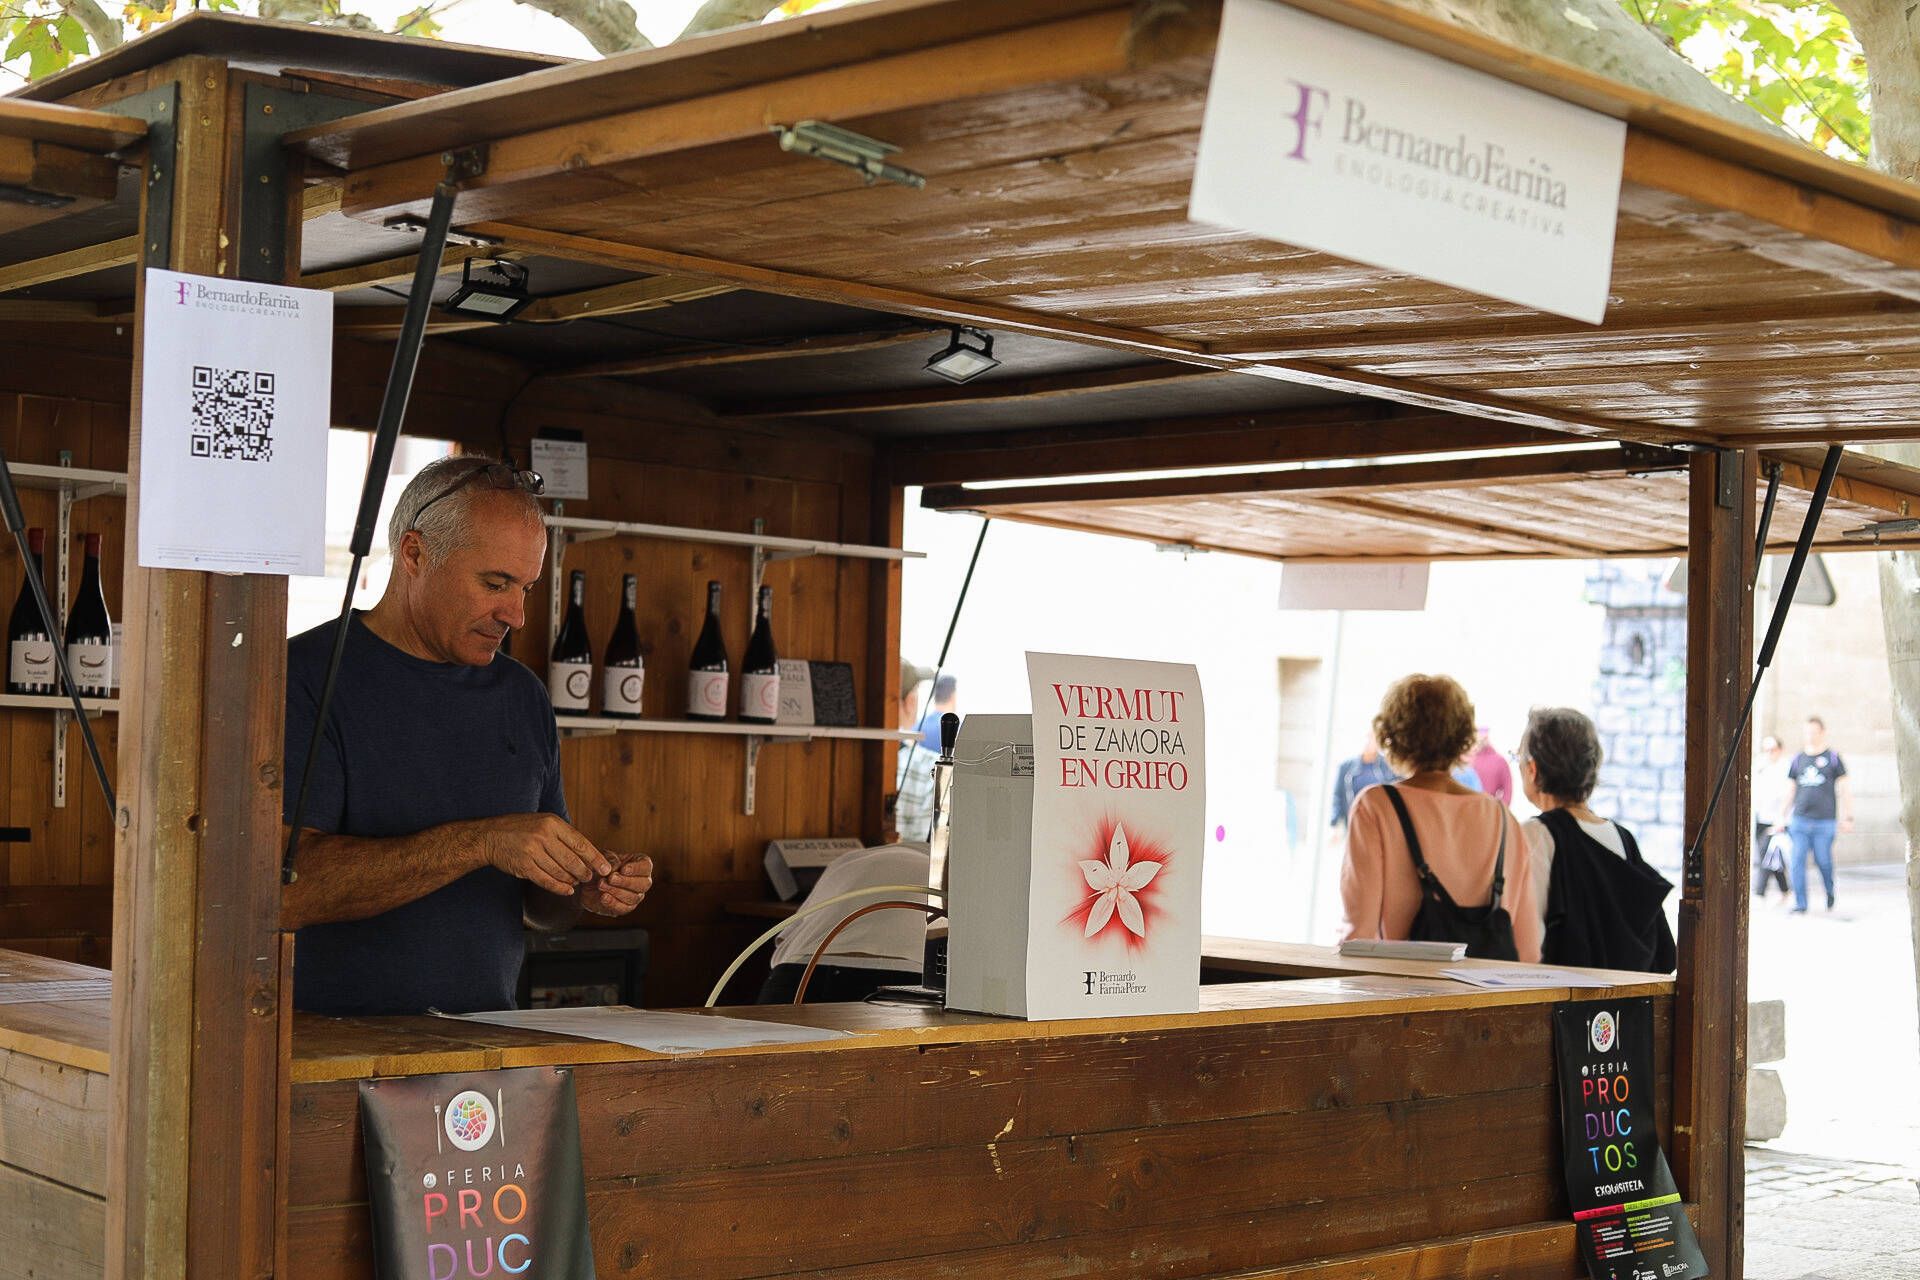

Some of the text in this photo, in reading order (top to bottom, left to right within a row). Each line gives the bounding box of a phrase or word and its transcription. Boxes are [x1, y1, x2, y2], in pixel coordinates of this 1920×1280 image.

[1051, 684, 1184, 723] VERMUT
[1059, 724, 1186, 756] DE ZAMORA
[1059, 758, 1100, 788] EN
[1104, 759, 1188, 791] GRIFO
[1099, 970, 1136, 982] Bernardo
[1592, 1061, 1629, 1075] FERIA
[1582, 1075, 1629, 1105] PRO
[1585, 1108, 1632, 1140] DUC
[447, 1163, 525, 1185] FERIA
[1588, 1142, 1638, 1175] TOS
[423, 1184, 527, 1233] PRO
[427, 1233, 532, 1280] DUC
